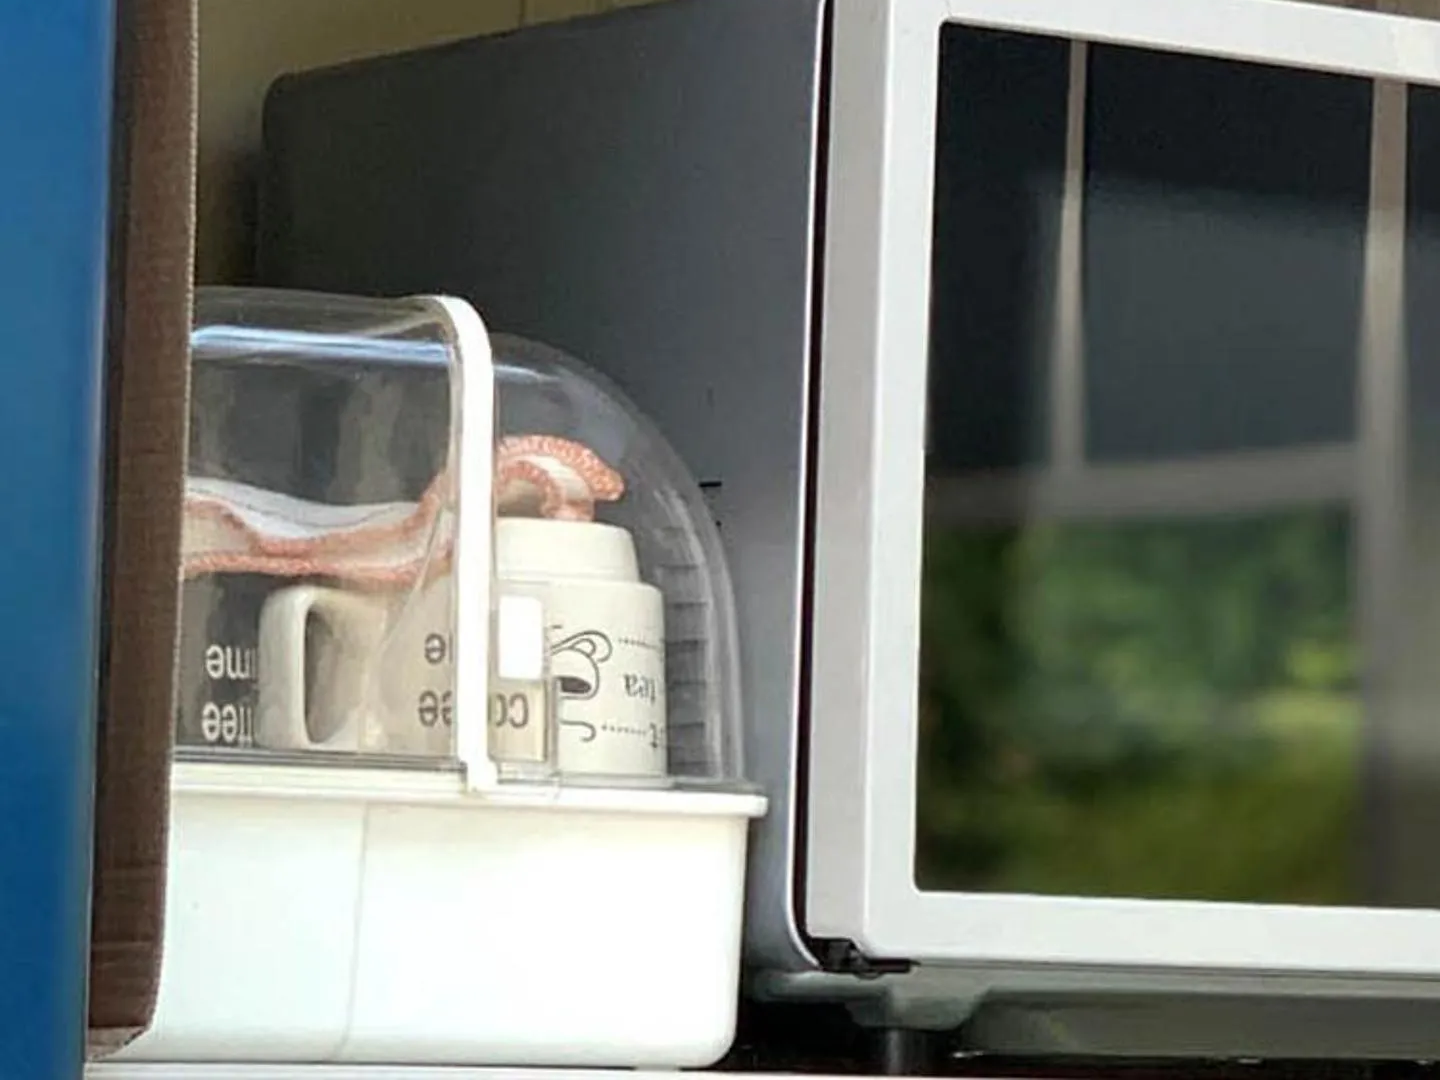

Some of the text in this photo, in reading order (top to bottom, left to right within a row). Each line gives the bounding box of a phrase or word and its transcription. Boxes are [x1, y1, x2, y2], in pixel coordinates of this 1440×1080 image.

[206, 645, 257, 680] ime
[202, 702, 254, 748] ffee
[418, 689, 529, 729] coee
